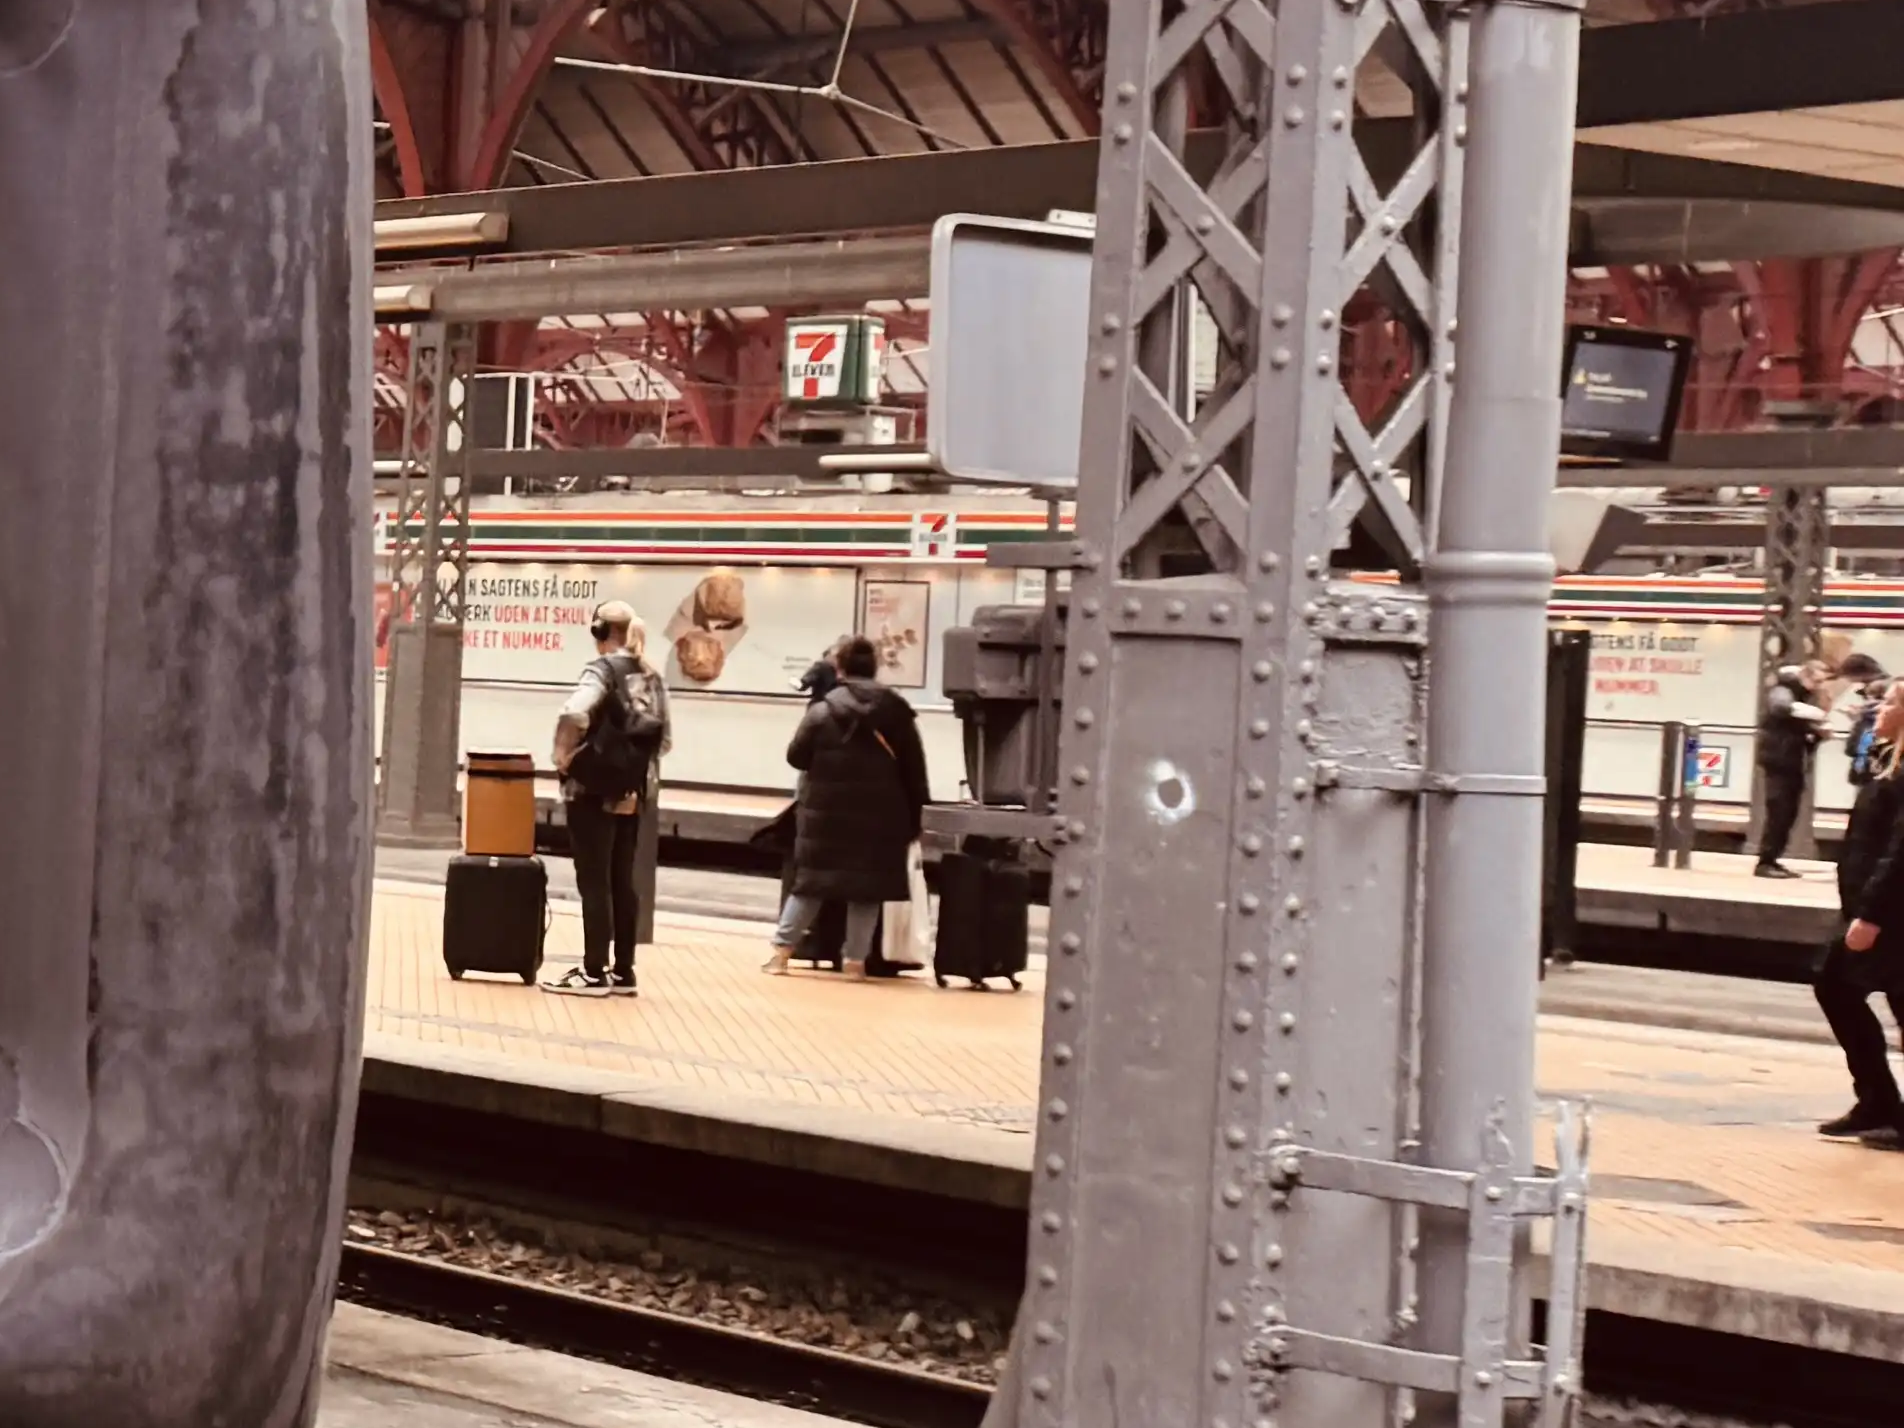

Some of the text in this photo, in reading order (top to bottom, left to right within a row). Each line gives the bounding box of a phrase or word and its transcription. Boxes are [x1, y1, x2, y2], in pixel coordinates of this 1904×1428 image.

[480, 578, 540, 598] SAGTENS
[543, 573, 560, 599] FÅ
[562, 579, 598, 600] GODT
[494, 605, 529, 624] UDEN
[533, 605, 550, 624] AT
[483, 630, 499, 649] ET
